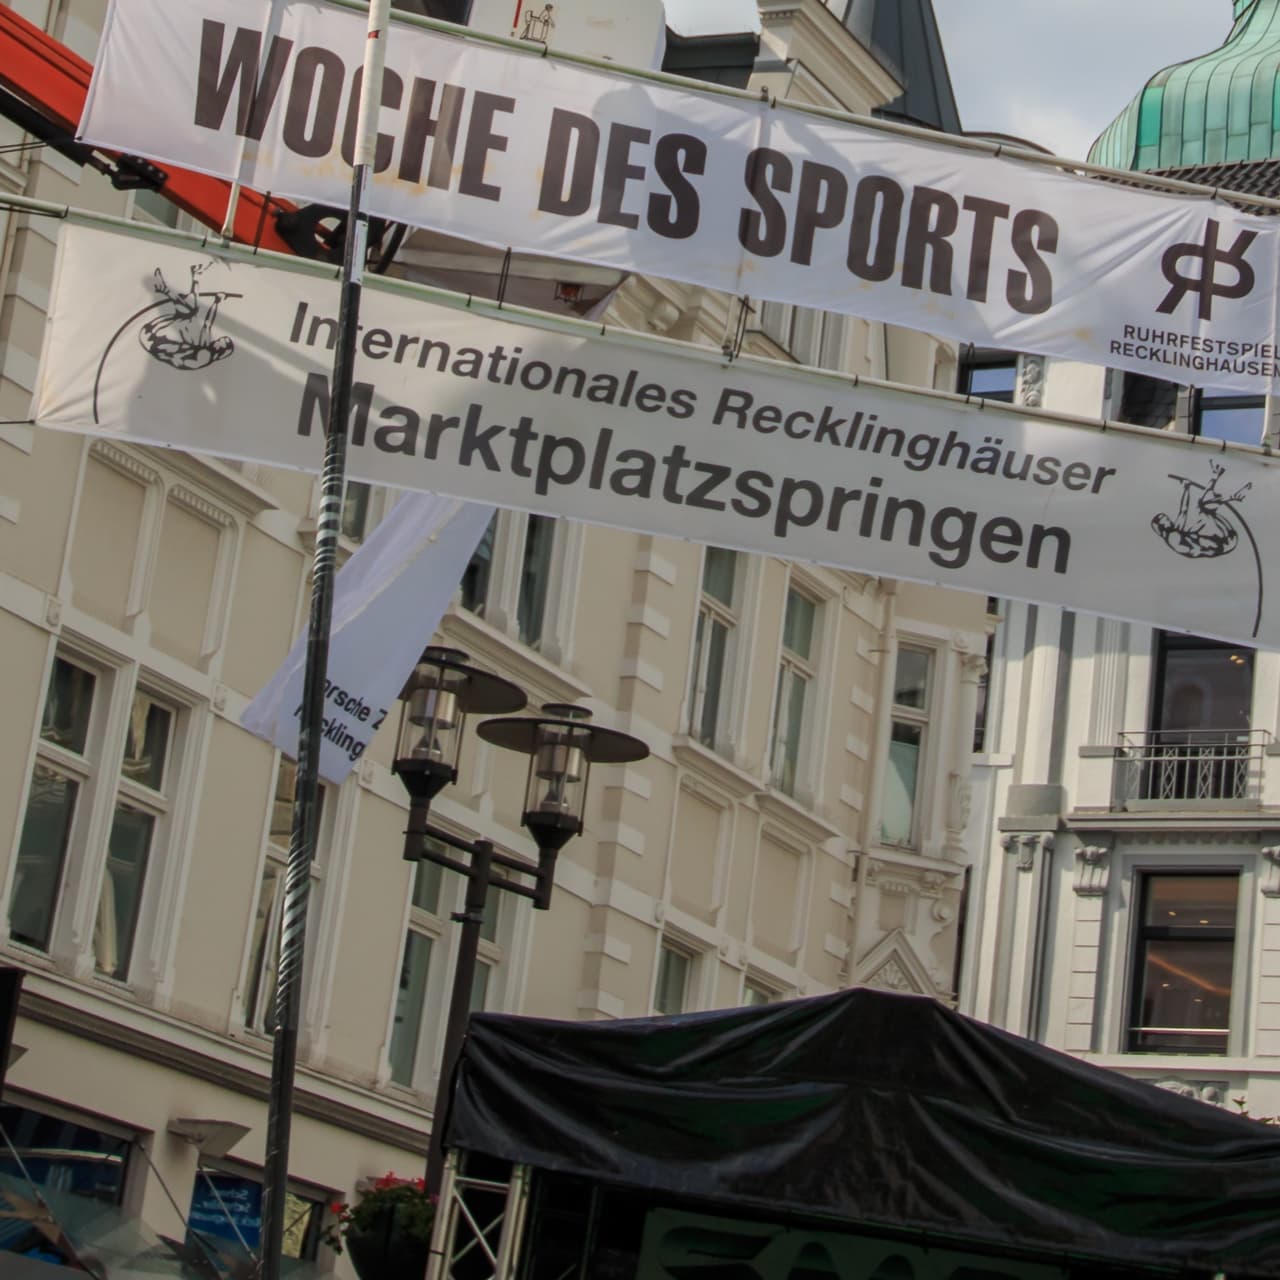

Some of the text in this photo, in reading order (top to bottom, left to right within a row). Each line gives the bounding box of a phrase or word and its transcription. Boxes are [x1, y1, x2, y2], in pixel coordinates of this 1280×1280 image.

[194, 17, 1060, 315] WOCHE DES SPORTS
[289, 301, 1117, 496] Inernationales Recklinghäuser
[297, 371, 1073, 575] Marktplatzspringen
